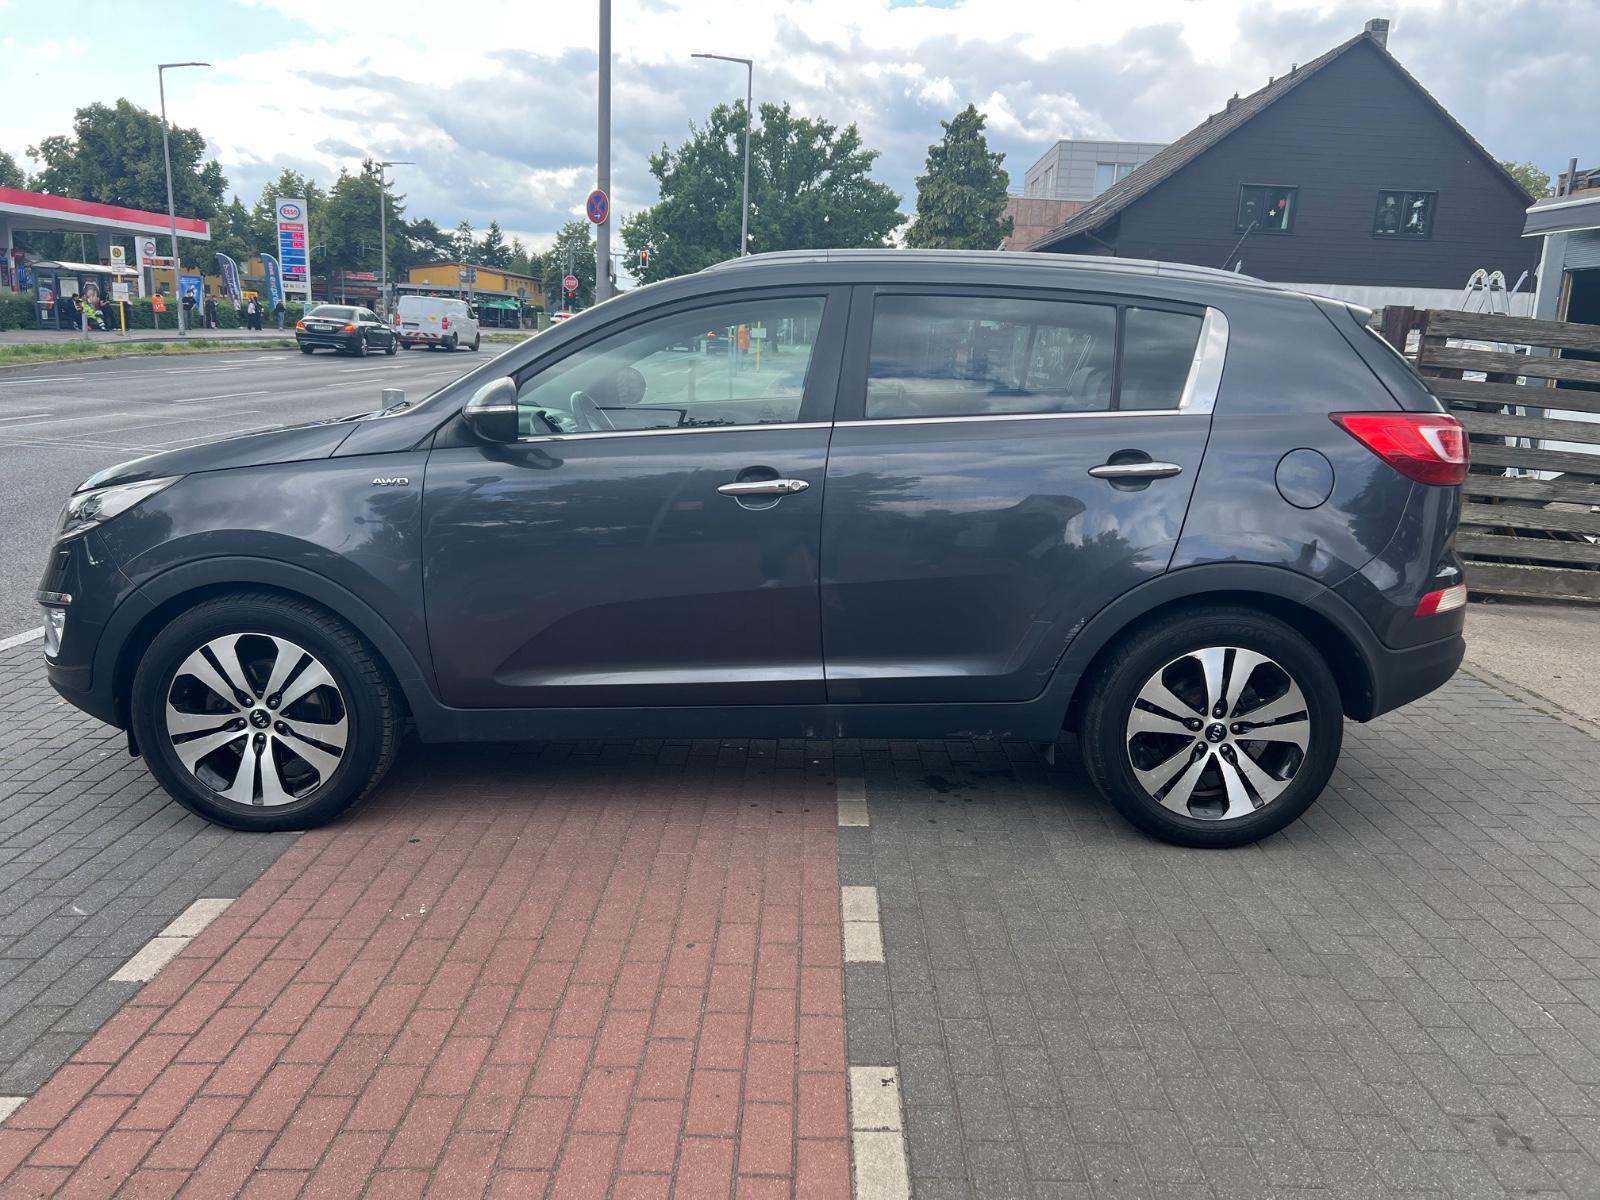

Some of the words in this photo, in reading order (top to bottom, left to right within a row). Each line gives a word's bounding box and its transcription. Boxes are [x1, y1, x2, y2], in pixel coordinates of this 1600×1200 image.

[283, 207, 298, 216] Esso
[372, 477, 409, 486] AWD
[1210, 724, 1222, 741] KIA
